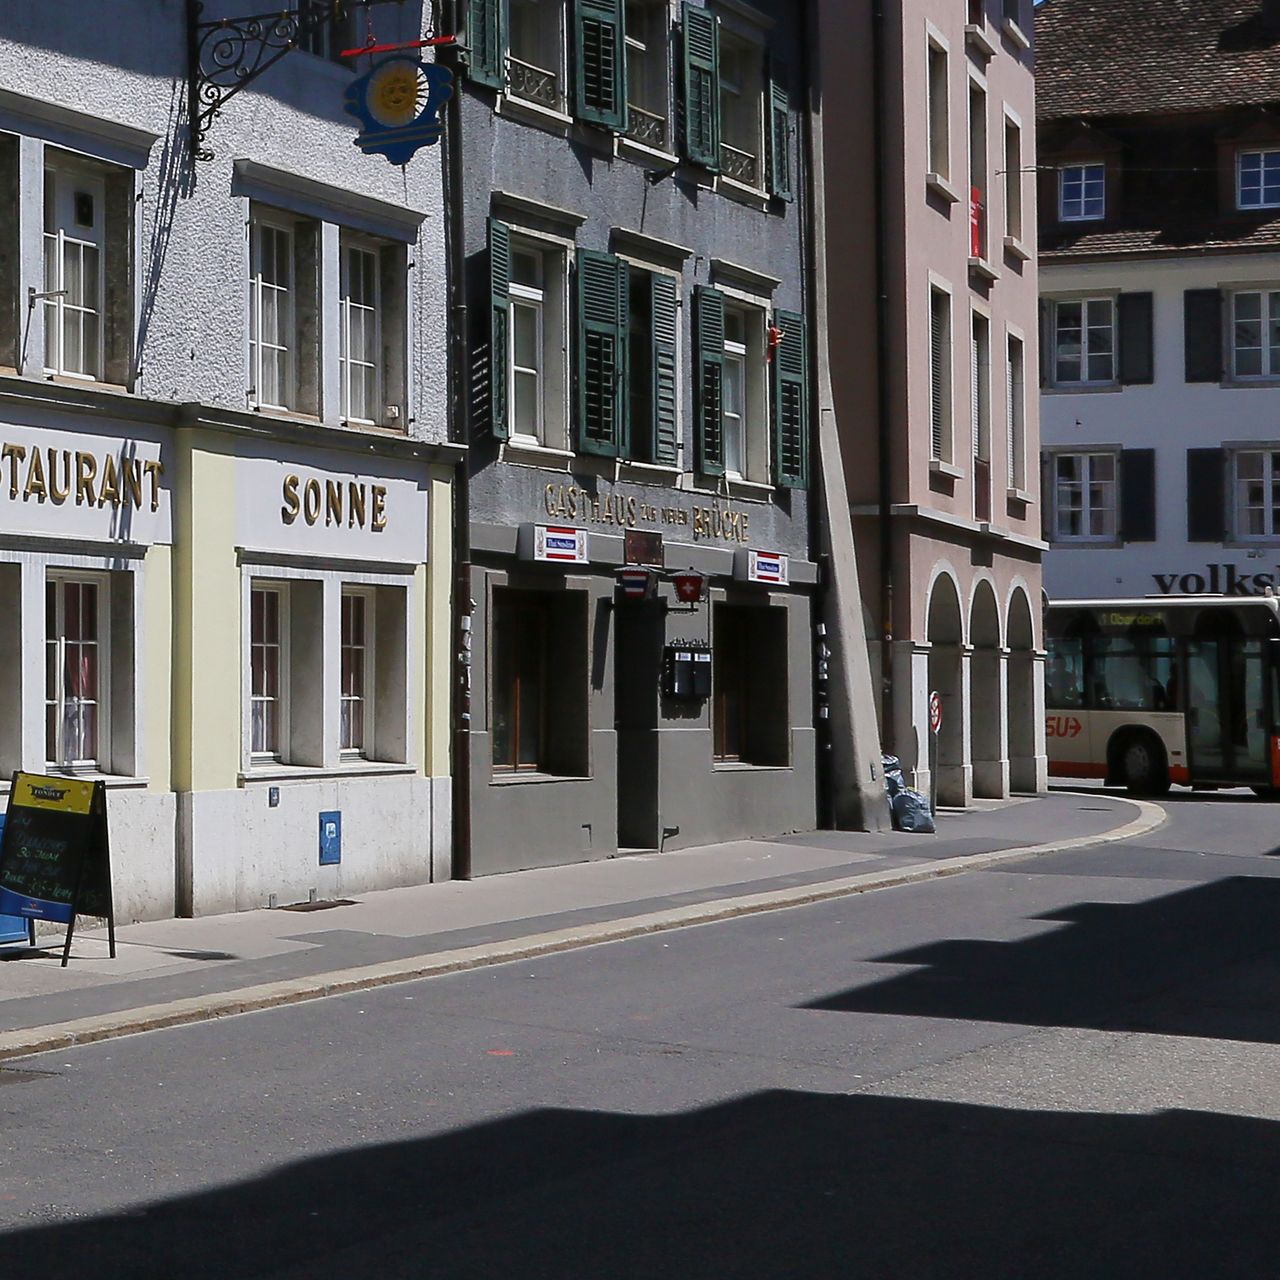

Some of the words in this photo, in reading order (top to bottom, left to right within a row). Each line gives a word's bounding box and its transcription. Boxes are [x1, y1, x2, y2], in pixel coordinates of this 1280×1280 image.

[281, 474, 387, 533] SONNE
[544, 483, 636, 527] GASTHAUS
[640, 503, 657, 522] ZUR
[660, 506, 688, 526] NEUEN
[692, 499, 751, 543] BRÜCKE
[1151, 563, 1280, 595] volks
